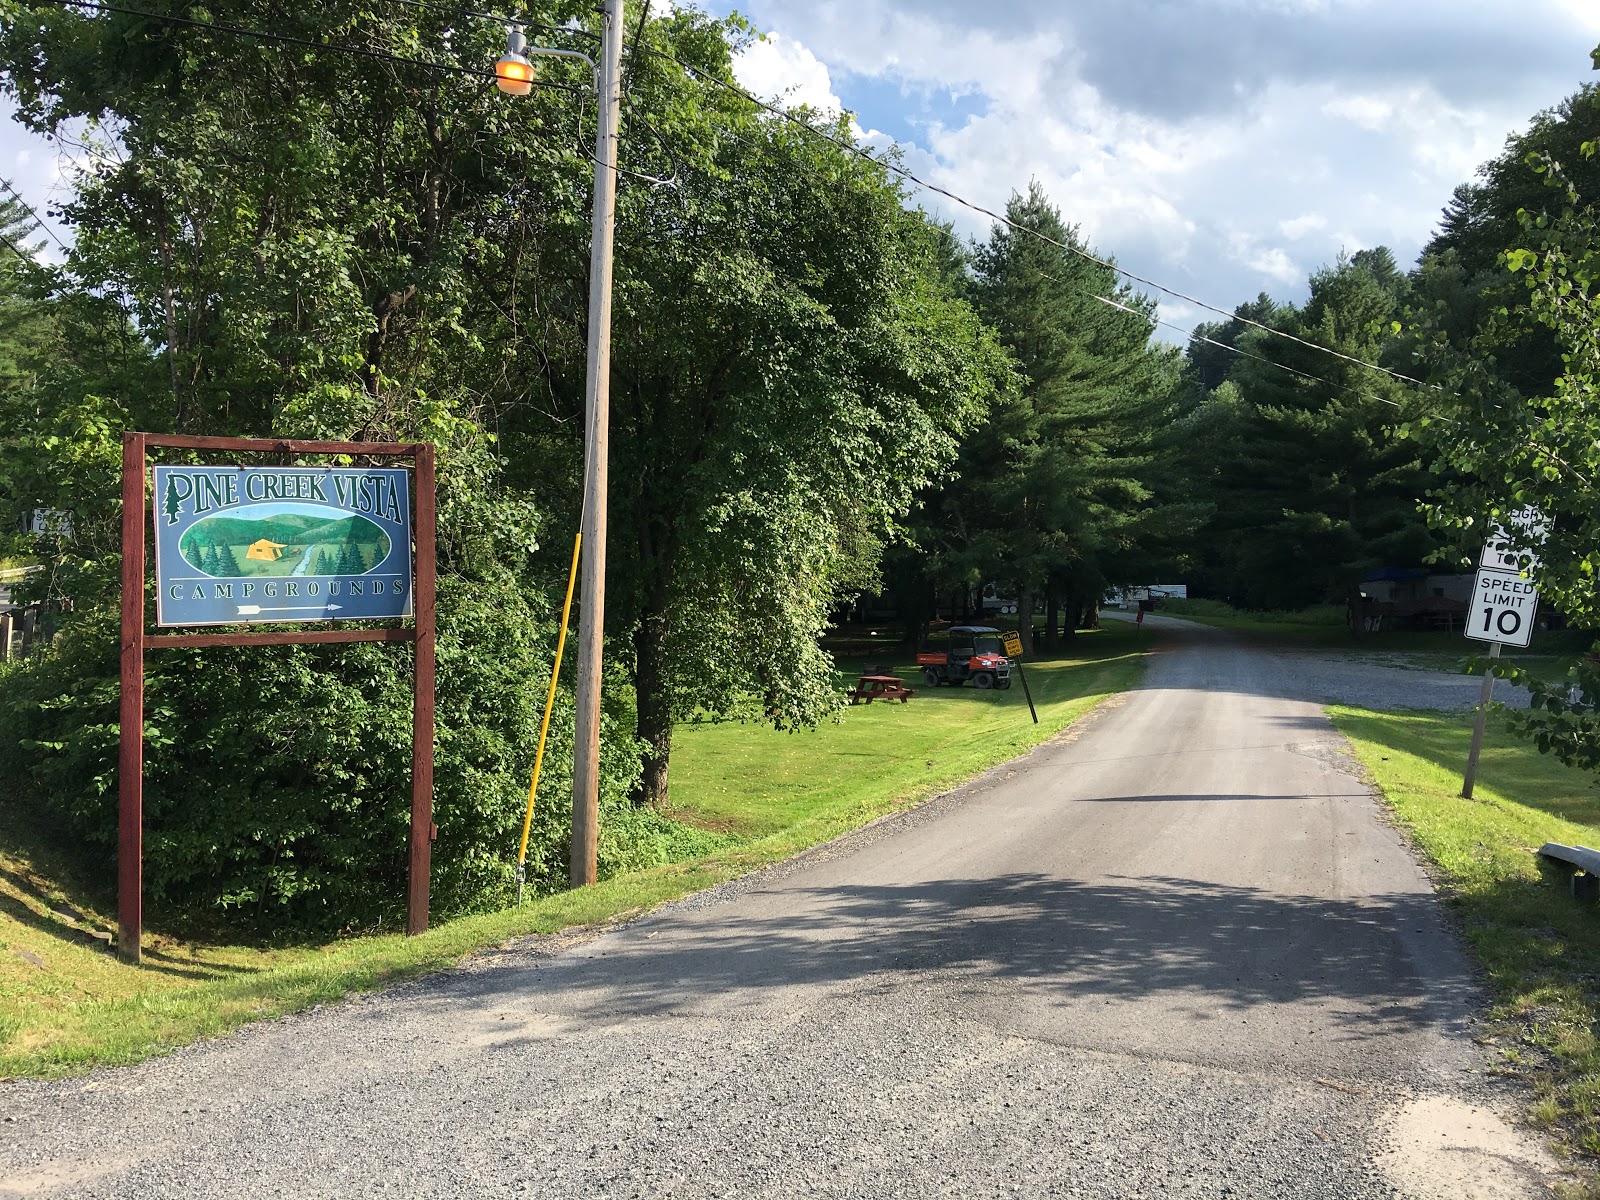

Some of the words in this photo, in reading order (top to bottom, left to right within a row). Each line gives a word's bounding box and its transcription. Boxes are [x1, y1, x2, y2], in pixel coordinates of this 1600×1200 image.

[162, 470, 239, 526] PINE
[245, 472, 328, 502] CREEK
[332, 474, 403, 525] VISTA
[169, 579, 404, 600] CAMPGROUNDS
[1481, 577, 1534, 595] SPEED
[1483, 592, 1526, 608] LIMIT
[1483, 607, 1522, 635] 10
